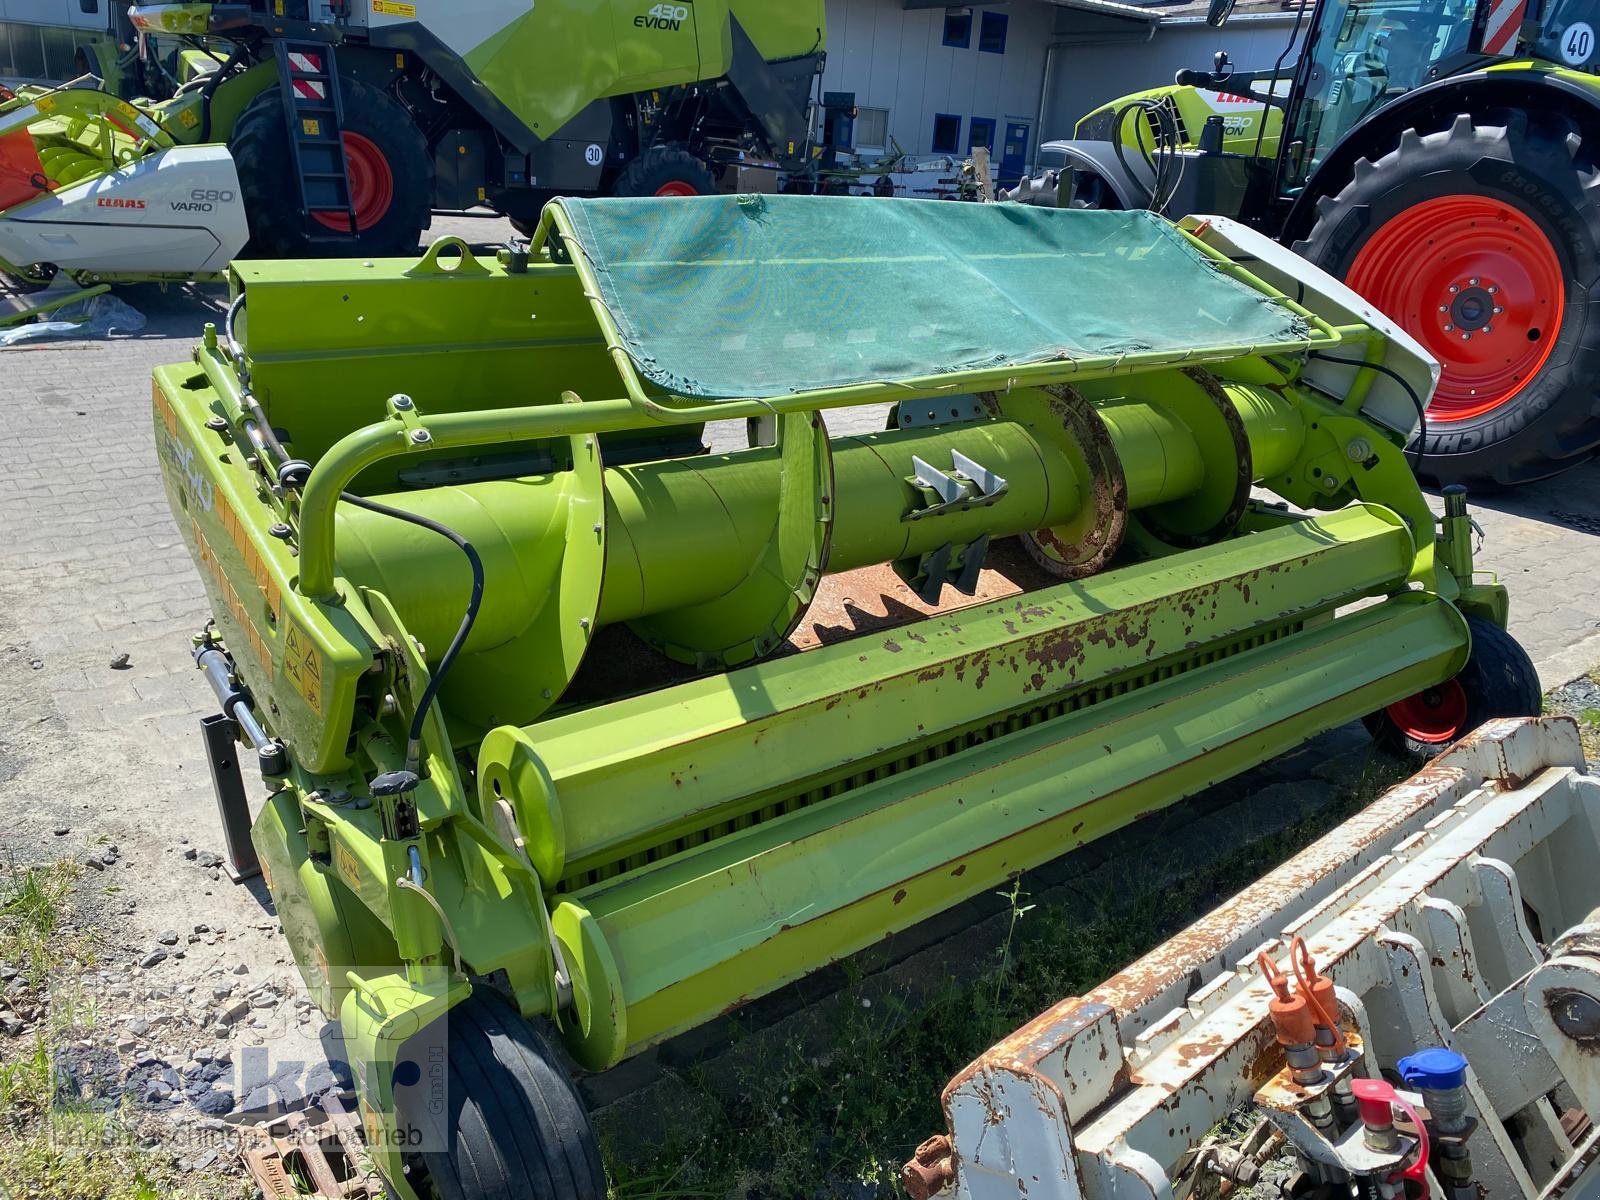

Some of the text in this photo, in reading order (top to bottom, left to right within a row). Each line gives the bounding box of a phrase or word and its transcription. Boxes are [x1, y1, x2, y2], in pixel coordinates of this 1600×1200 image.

[649, 4, 688, 20] 430
[633, 15, 680, 31] EVION
[1567, 30, 1589, 57] 40
[588, 148, 600, 162] 30
[191, 189, 234, 202] 680
[97, 198, 146, 209] CLAAS
[170, 202, 213, 212] VARIO
